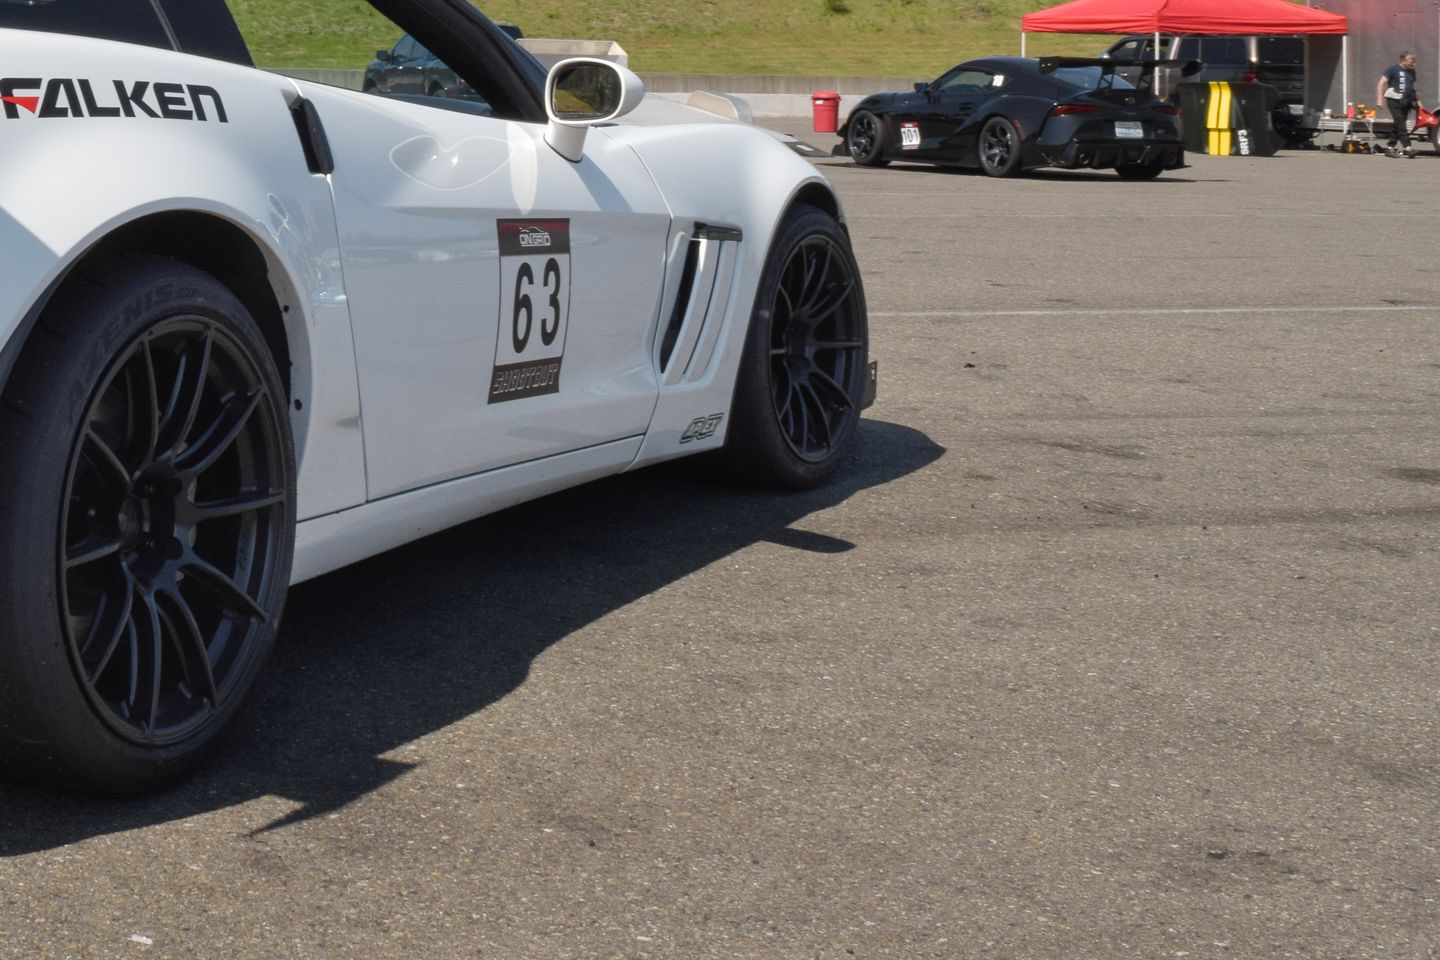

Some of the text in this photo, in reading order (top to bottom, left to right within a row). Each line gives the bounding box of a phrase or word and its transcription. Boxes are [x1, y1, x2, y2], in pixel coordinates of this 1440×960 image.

[902, 128, 919, 143] 101
[512, 257, 561, 354] 63
[492, 362, 560, 394] SHOOTOUT
